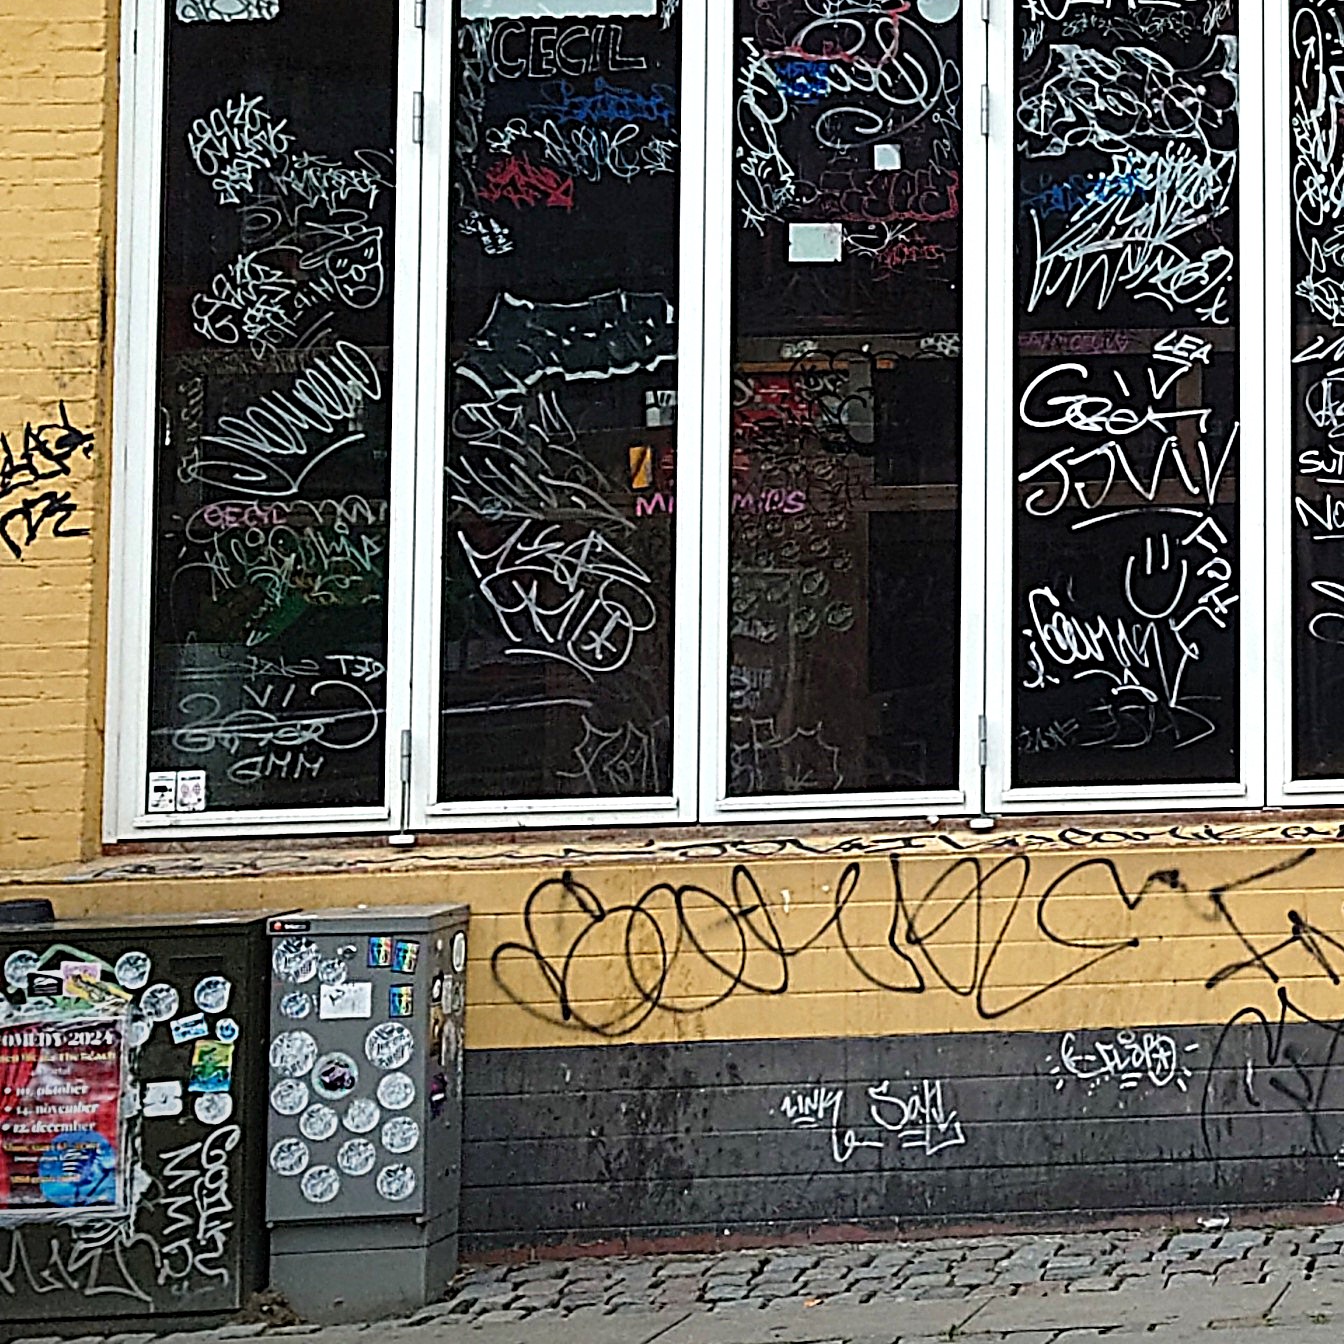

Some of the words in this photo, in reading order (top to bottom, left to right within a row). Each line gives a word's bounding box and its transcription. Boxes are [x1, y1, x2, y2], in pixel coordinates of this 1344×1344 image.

[492, 21, 647, 78] CECIL
[0, 1031, 66, 1047] OMEDY
[68, 1030, 113, 1046] 2024
[36, 1101, 99, 1114] november
[31, 1120, 96, 1133] december
